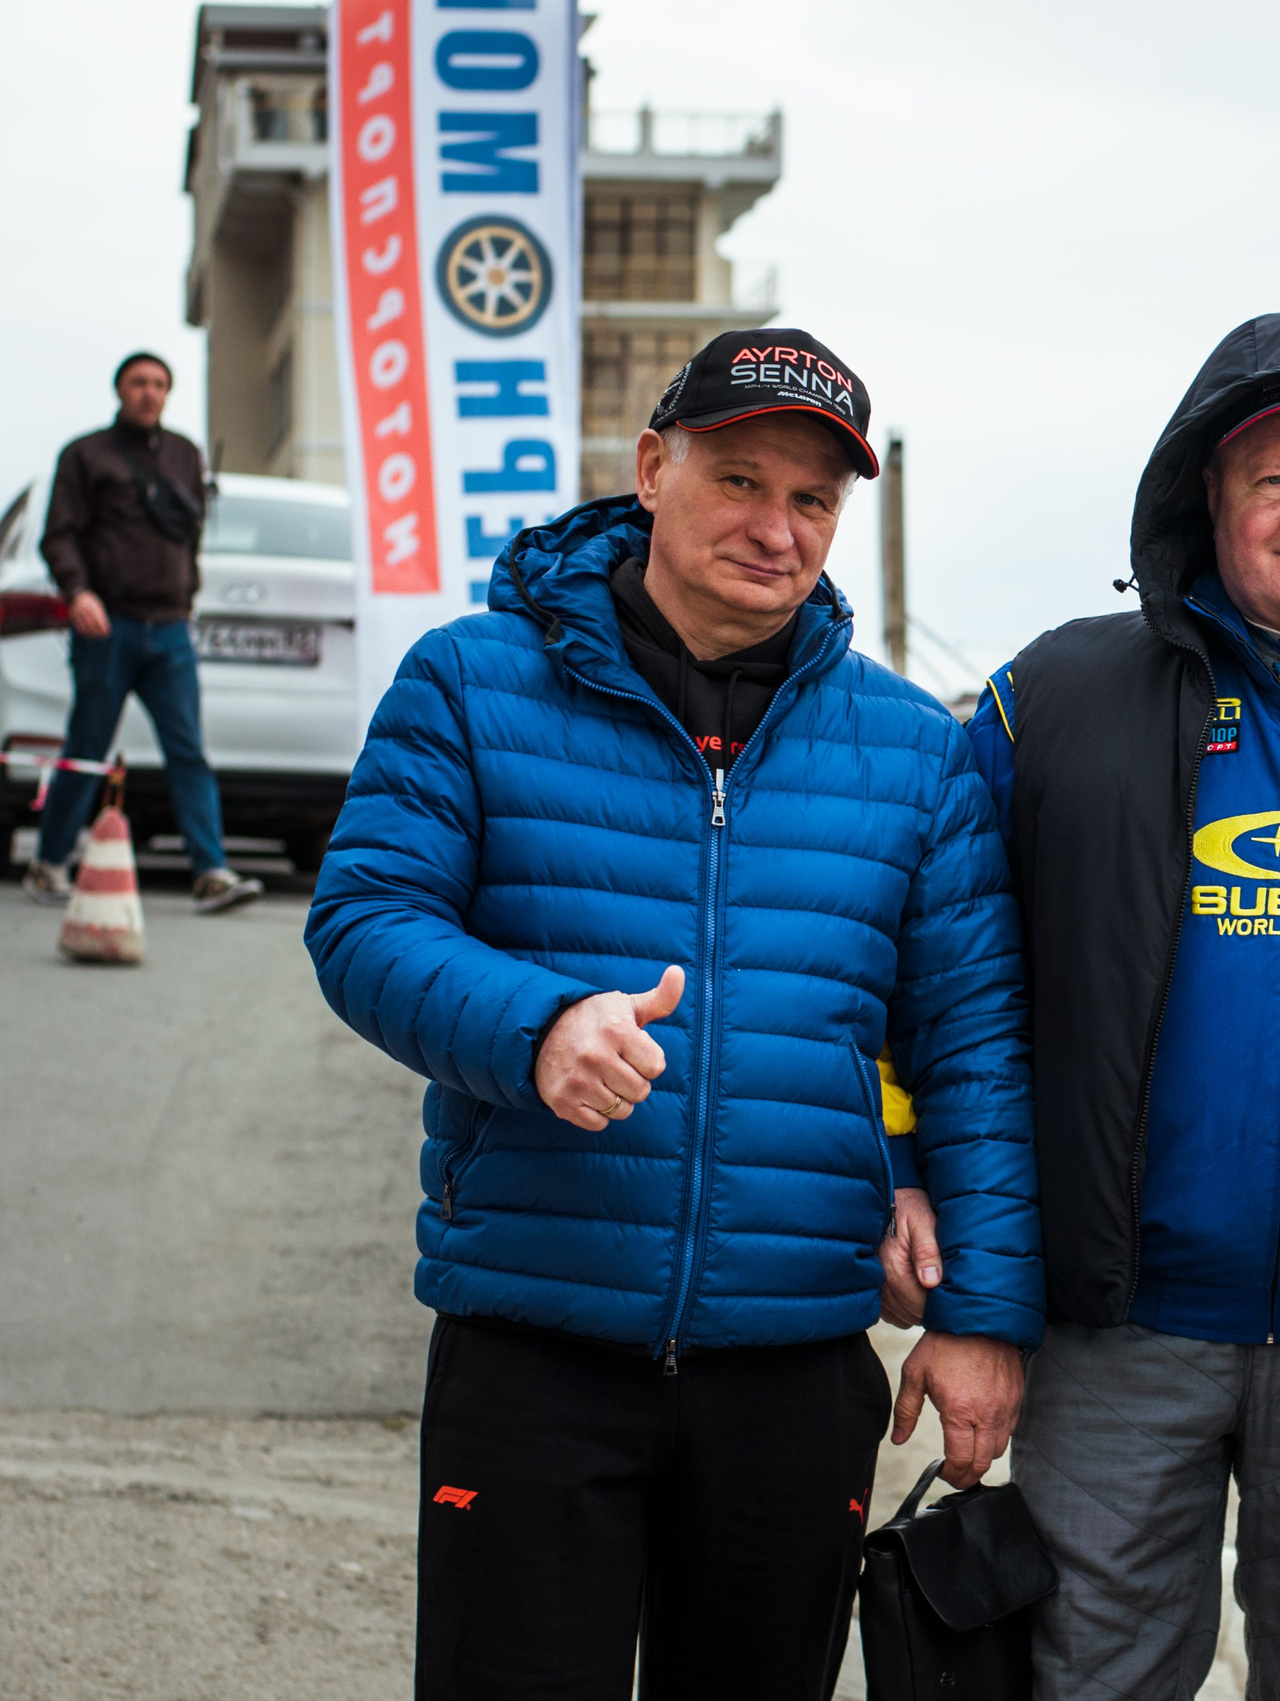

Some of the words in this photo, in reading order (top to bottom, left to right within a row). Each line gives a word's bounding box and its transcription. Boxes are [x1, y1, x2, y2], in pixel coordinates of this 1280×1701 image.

[732, 346, 853, 393] AYRTON
[730, 363, 854, 417] SENNA
[771, 384, 798, 392] WORLD
[777, 390, 822, 408] McLaren
